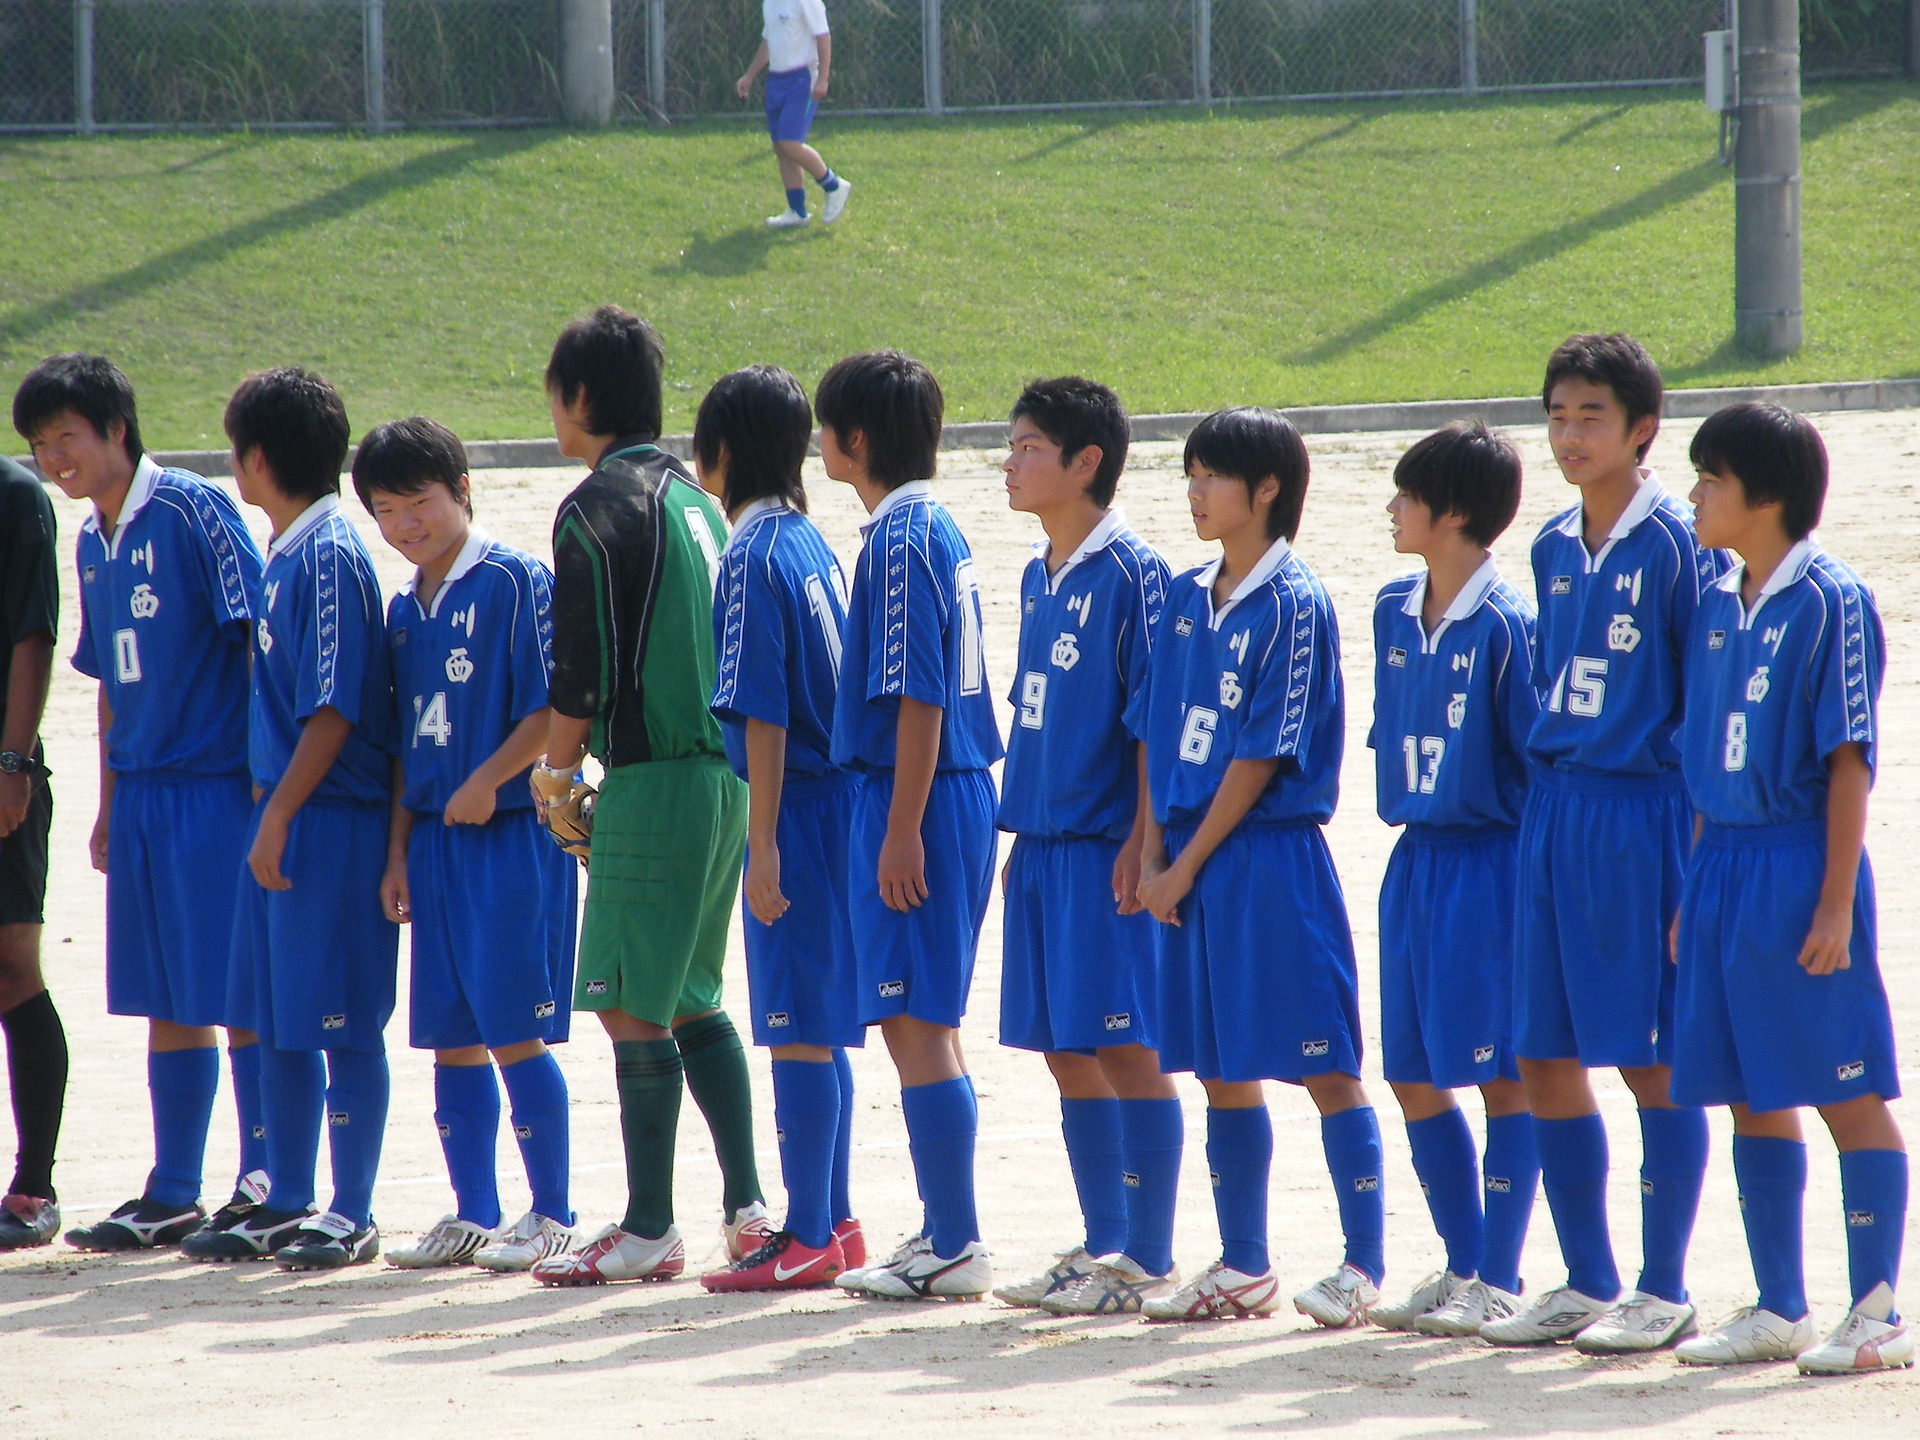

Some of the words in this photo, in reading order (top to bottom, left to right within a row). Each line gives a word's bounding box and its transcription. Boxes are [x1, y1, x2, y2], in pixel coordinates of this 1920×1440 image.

[445, 602, 476, 683] 川西
[1051, 591, 1092, 672] 川西
[1608, 568, 1644, 654] 川西
[1020, 671, 1048, 730] 9
[1220, 628, 1250, 710] 川西
[1448, 647, 1476, 730] 川西
[1549, 656, 1609, 717] 15
[1747, 621, 1788, 703] 川西
[411, 692, 452, 748] 14
[1724, 712, 1748, 772] 8
[1403, 735, 1446, 794] 13
